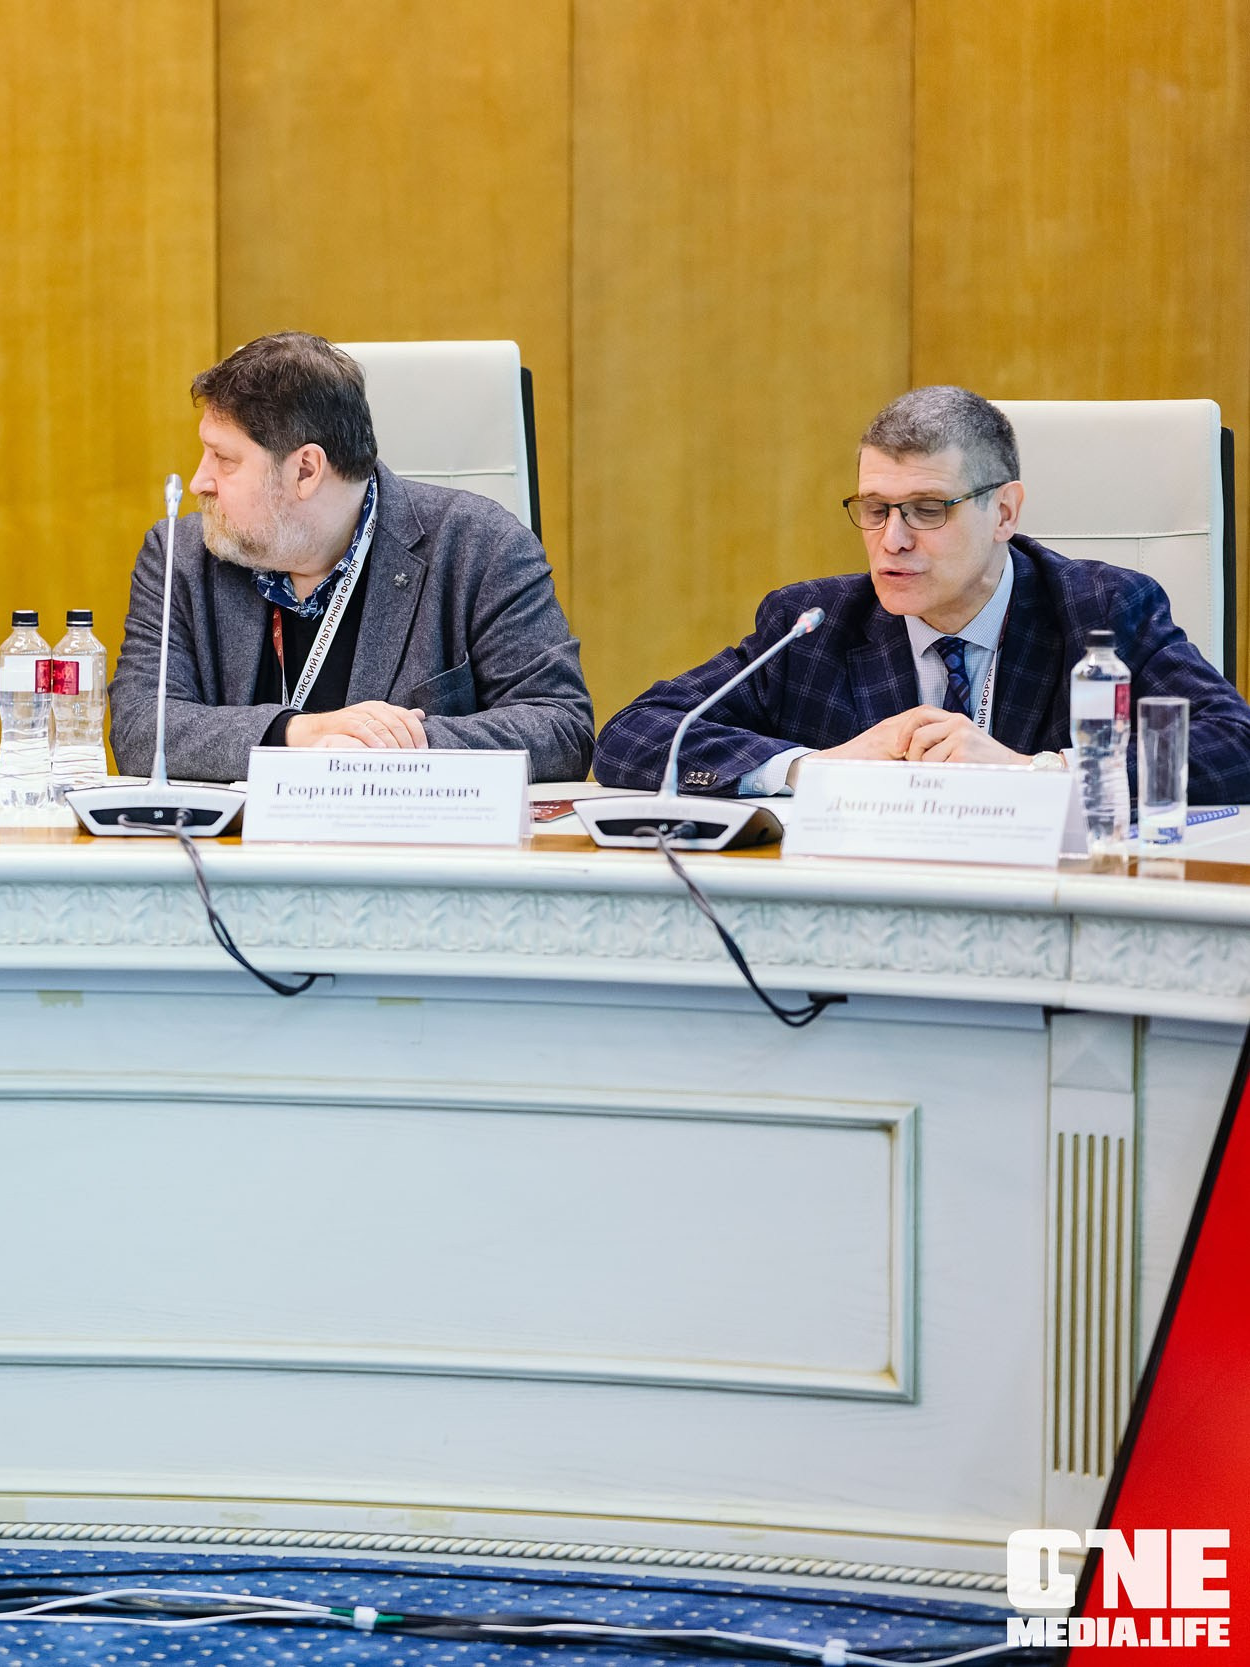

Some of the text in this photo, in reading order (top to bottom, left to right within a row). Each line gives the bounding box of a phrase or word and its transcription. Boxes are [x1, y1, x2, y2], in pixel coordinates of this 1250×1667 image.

[316, 595, 346, 658] КУЛЬТУРНЫЙ
[341, 559, 359, 594] ФОРУМ
[329, 759, 431, 773] Василевич
[276, 782, 481, 800] Георгий Николаевич
[910, 774, 945, 790] Бак
[827, 796, 1016, 819] Дмитрий Петрович
